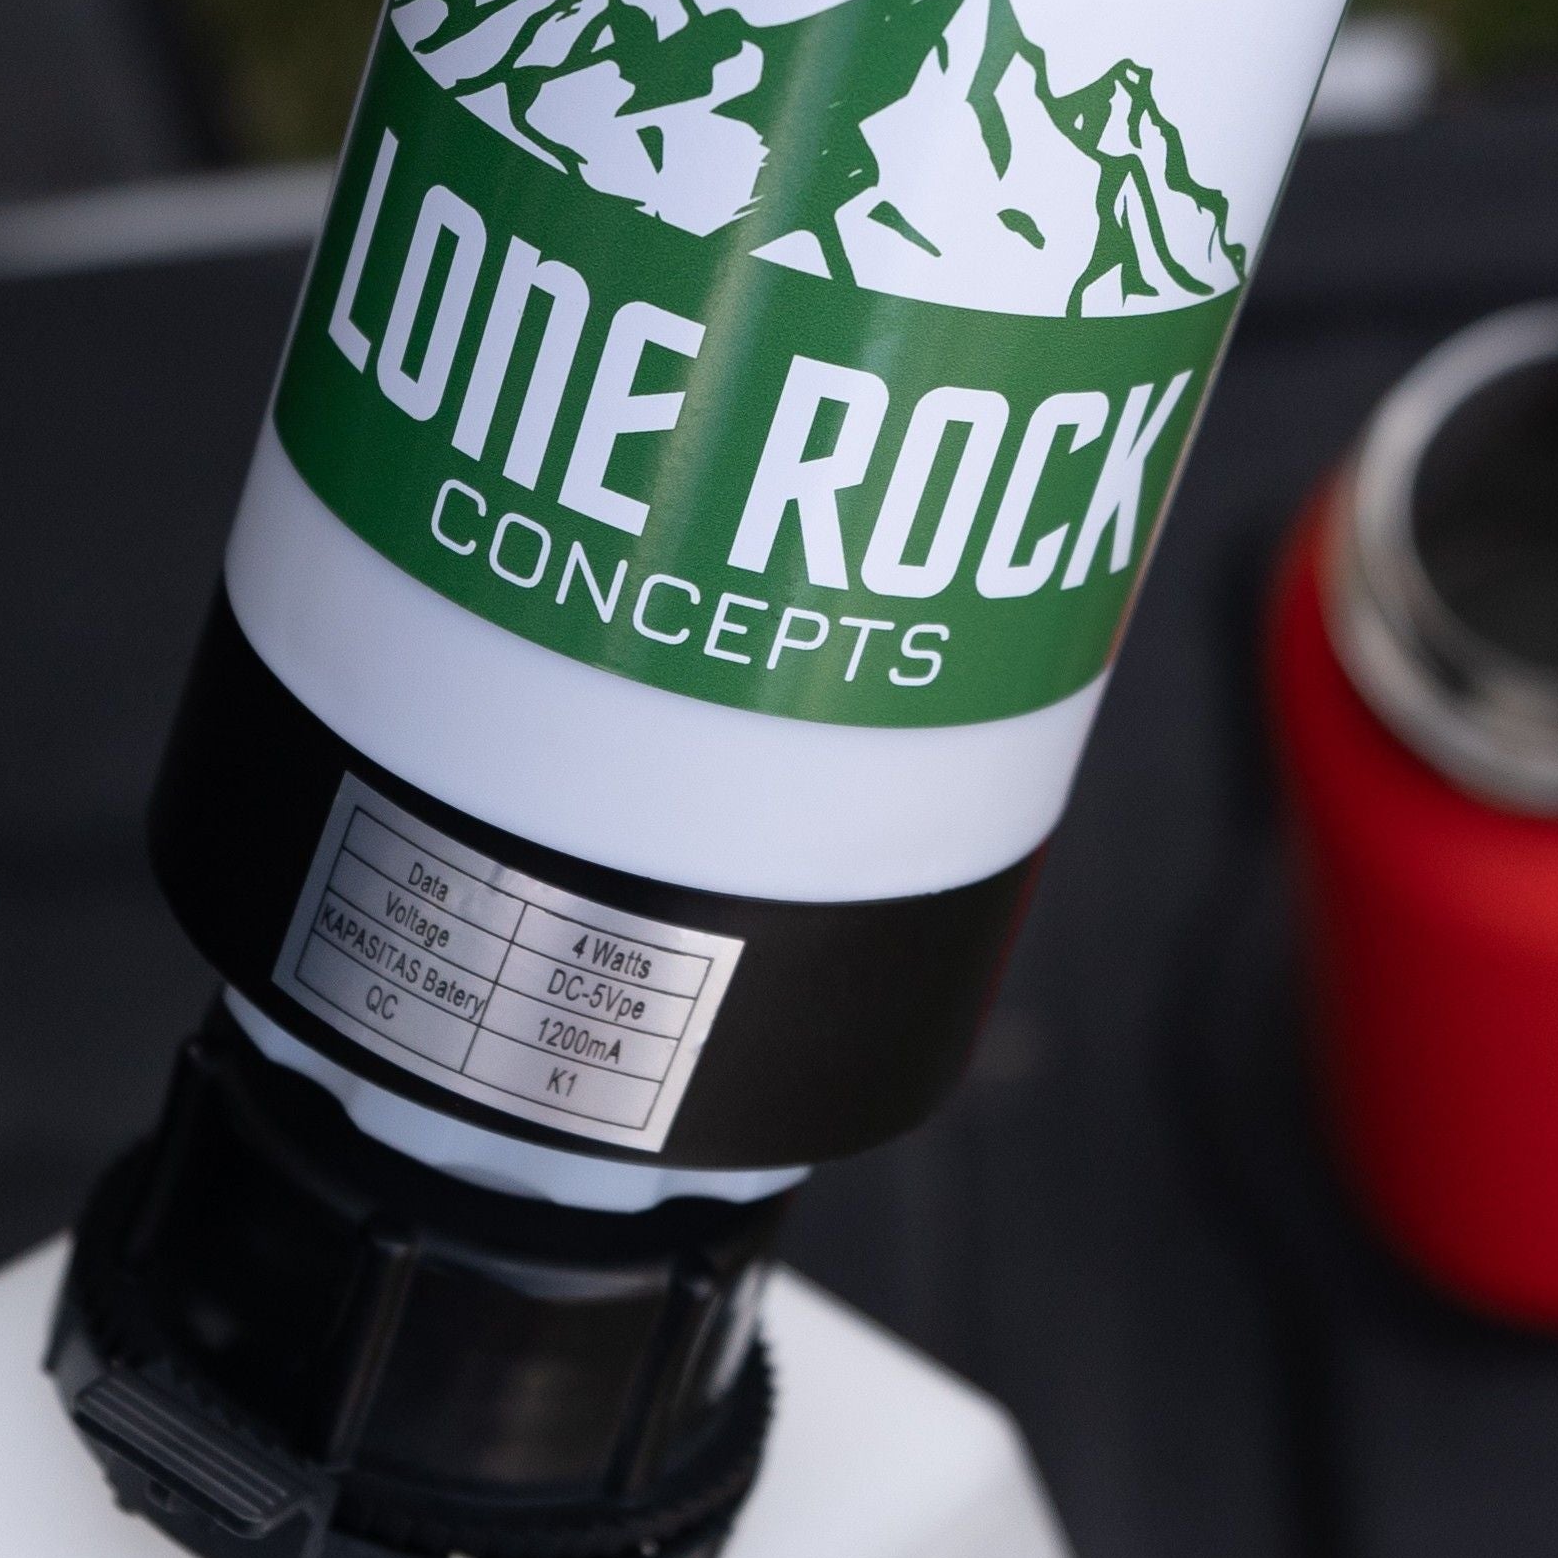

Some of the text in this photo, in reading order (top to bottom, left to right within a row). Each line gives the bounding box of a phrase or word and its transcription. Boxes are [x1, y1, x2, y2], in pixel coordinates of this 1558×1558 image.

[727, 354, 1194, 599] ROCK
[430, 479, 950, 686] CONCEPTS
[408, 862, 449, 902] Data
[385, 891, 451, 949] Voltage
[320, 904, 488, 1020] KAPASITAS Batery
[572, 934, 652, 980] 4 Watts
[365, 985, 399, 1021] QC
[547, 969, 646, 1021] DC-5Vpe
[538, 1017, 622, 1064] 1200mA
[546, 1068, 578, 1098] K1
